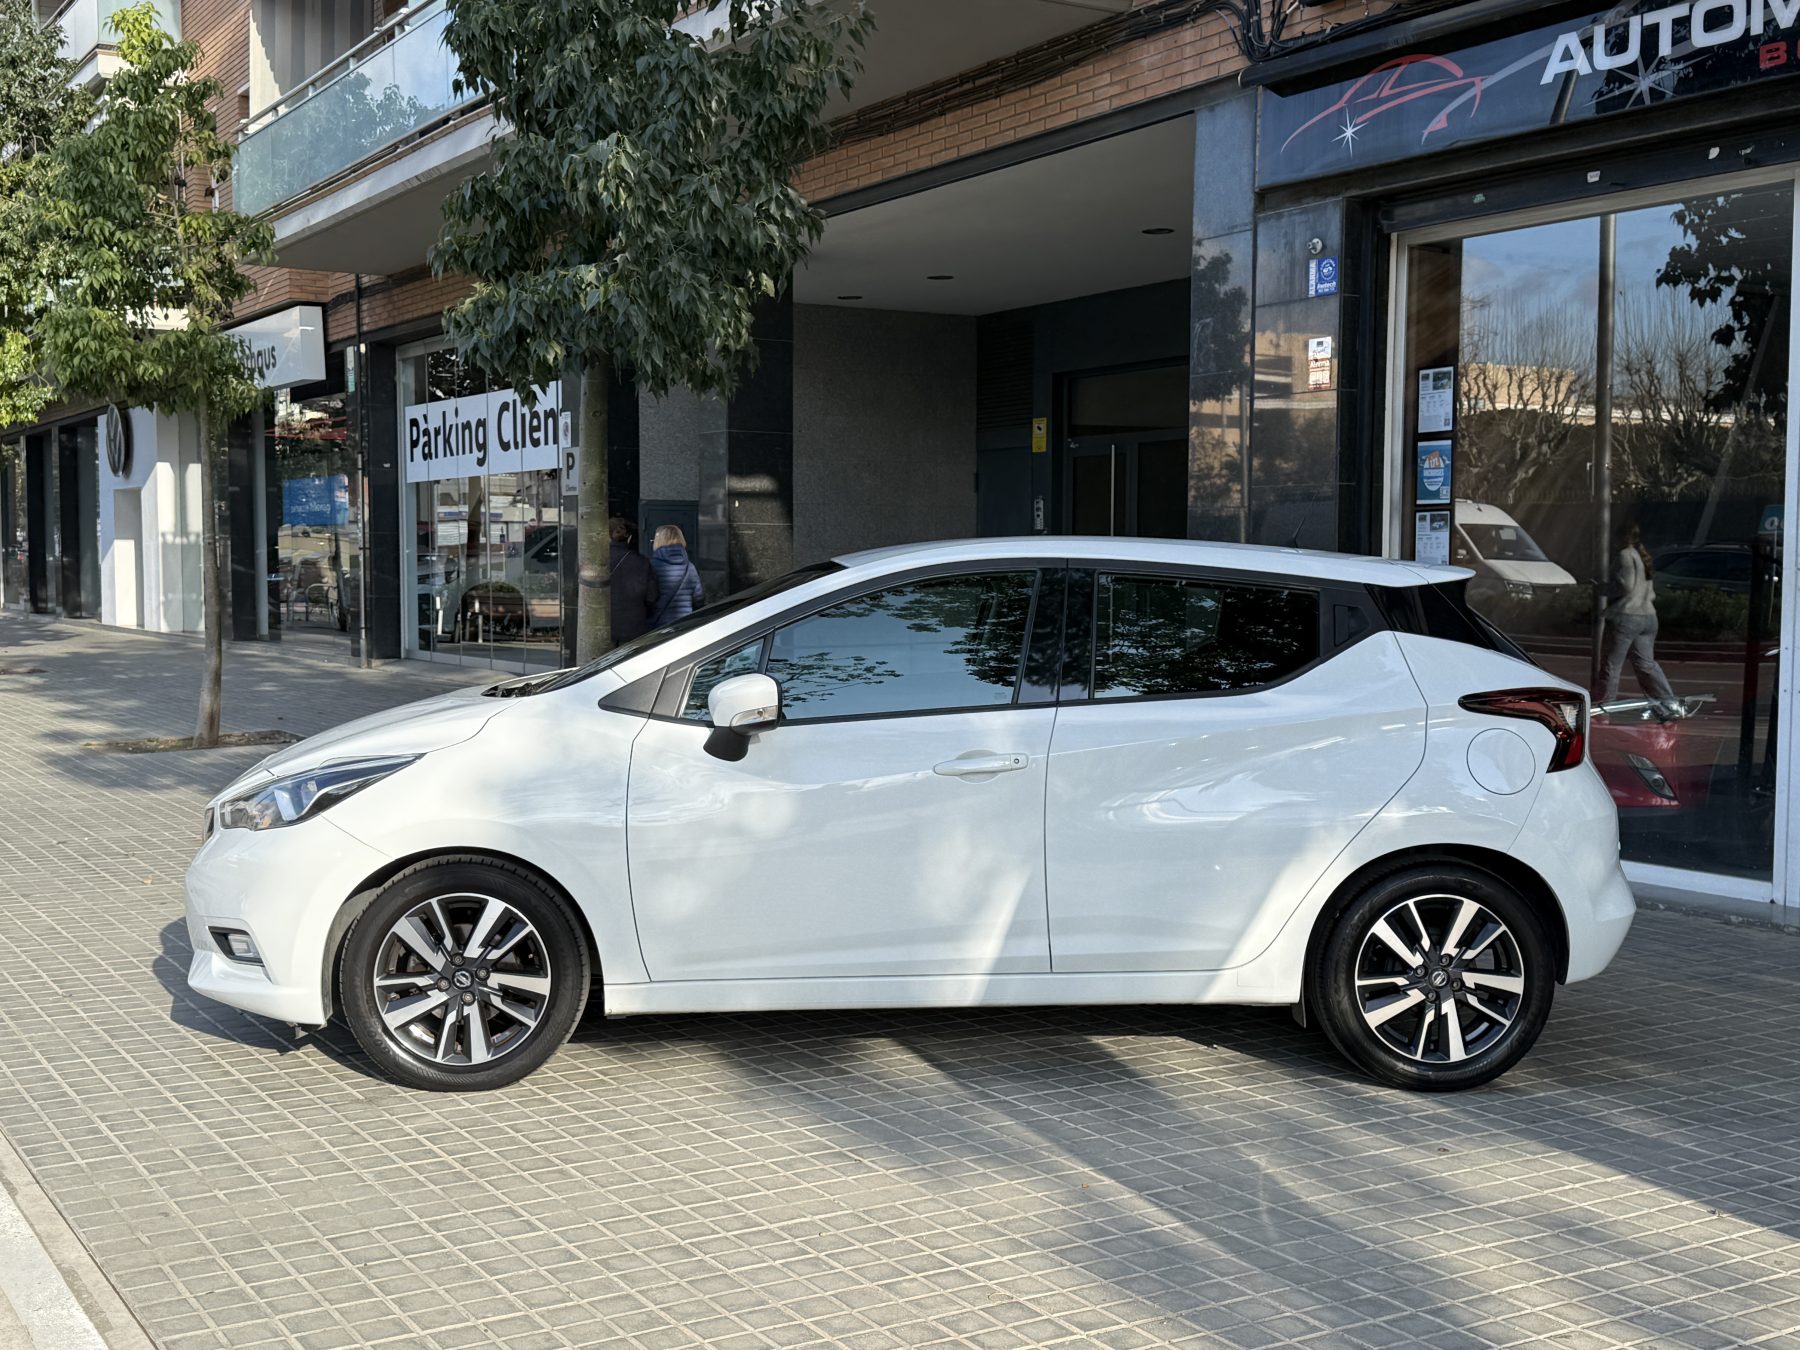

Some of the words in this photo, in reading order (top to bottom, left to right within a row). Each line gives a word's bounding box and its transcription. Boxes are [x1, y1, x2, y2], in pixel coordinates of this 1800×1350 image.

[1540, 0, 1800, 85] AUTOM
[1760, 39, 1800, 69] B
[497, 398, 563, 452] Clien
[566, 452, 575, 479] P
